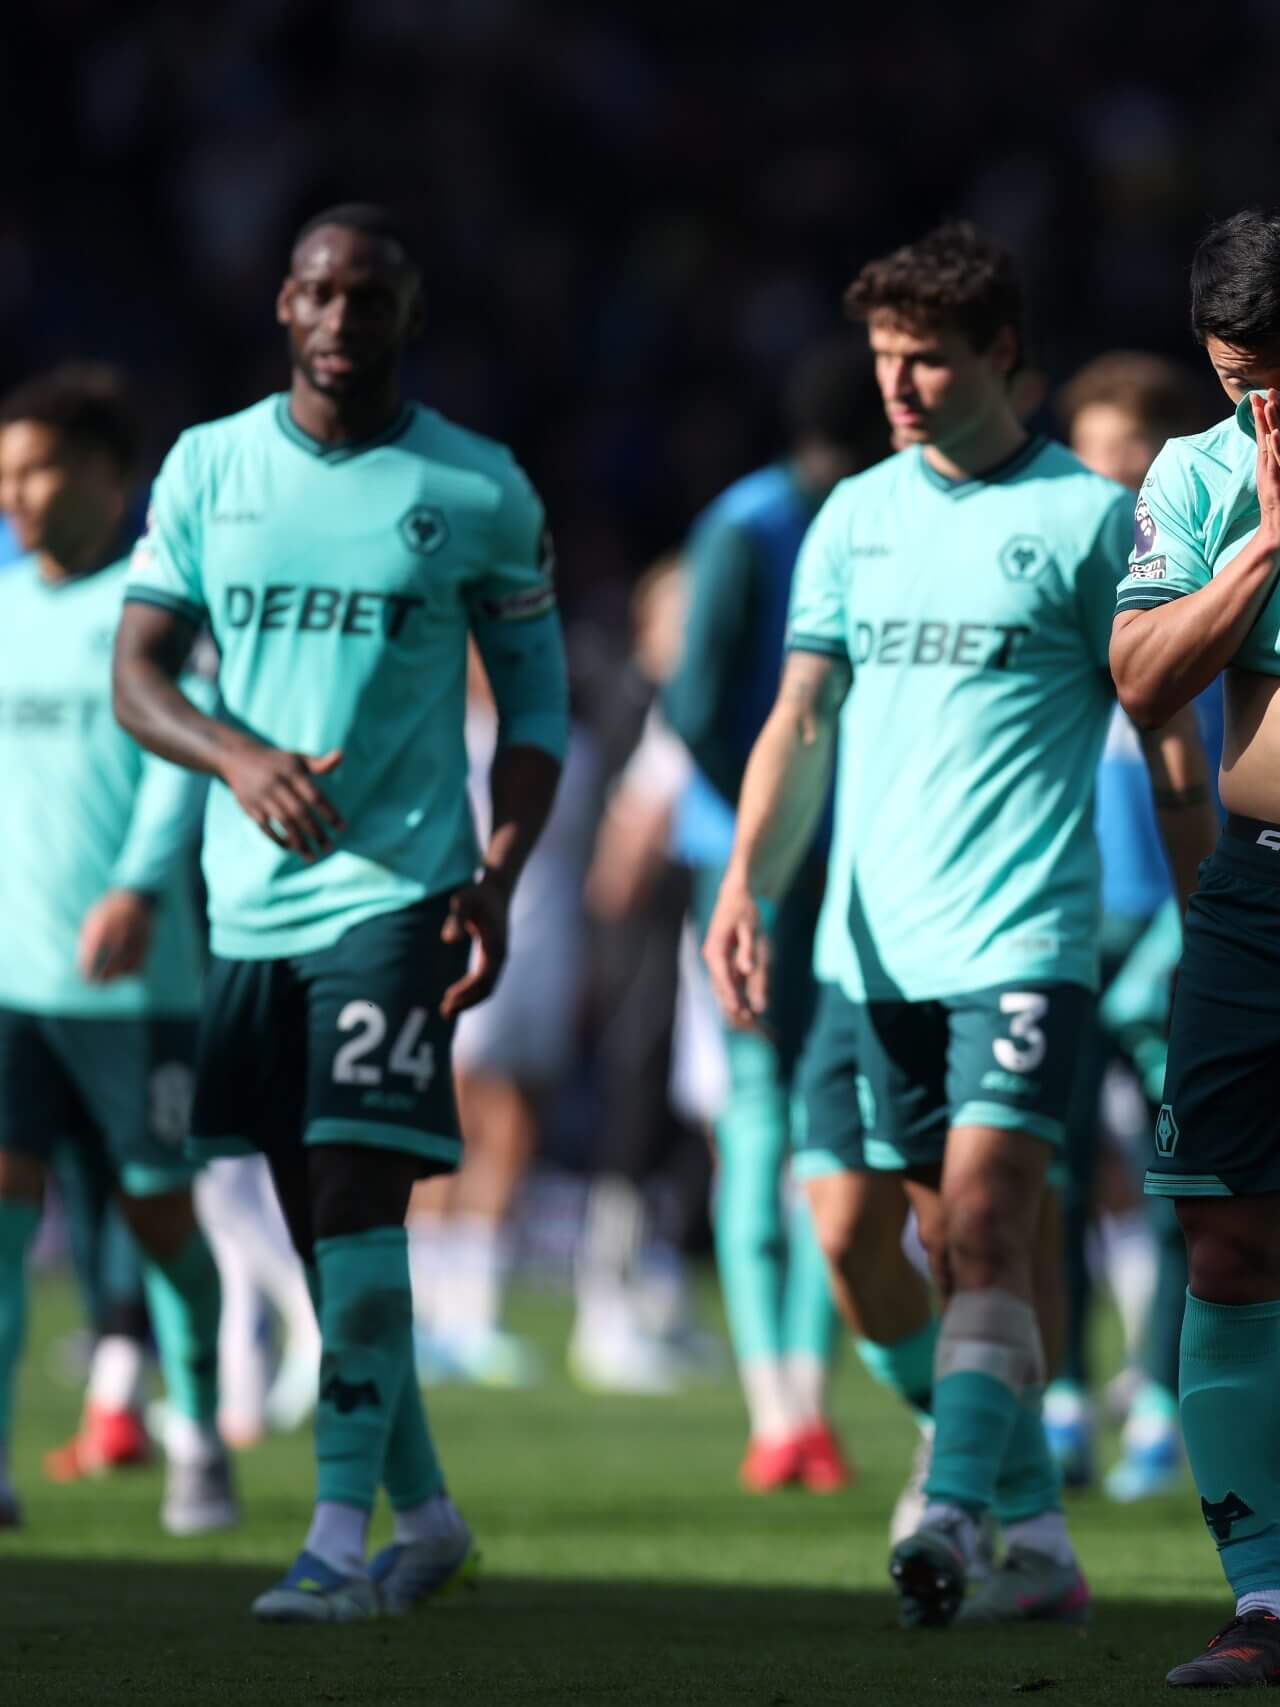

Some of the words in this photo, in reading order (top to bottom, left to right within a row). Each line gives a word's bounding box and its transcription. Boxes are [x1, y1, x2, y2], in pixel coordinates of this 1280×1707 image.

[225, 584, 426, 640] DEBET
[853, 620, 1031, 669] DEBET
[332, 999, 435, 1093] 24
[992, 991, 1050, 1073] 3
